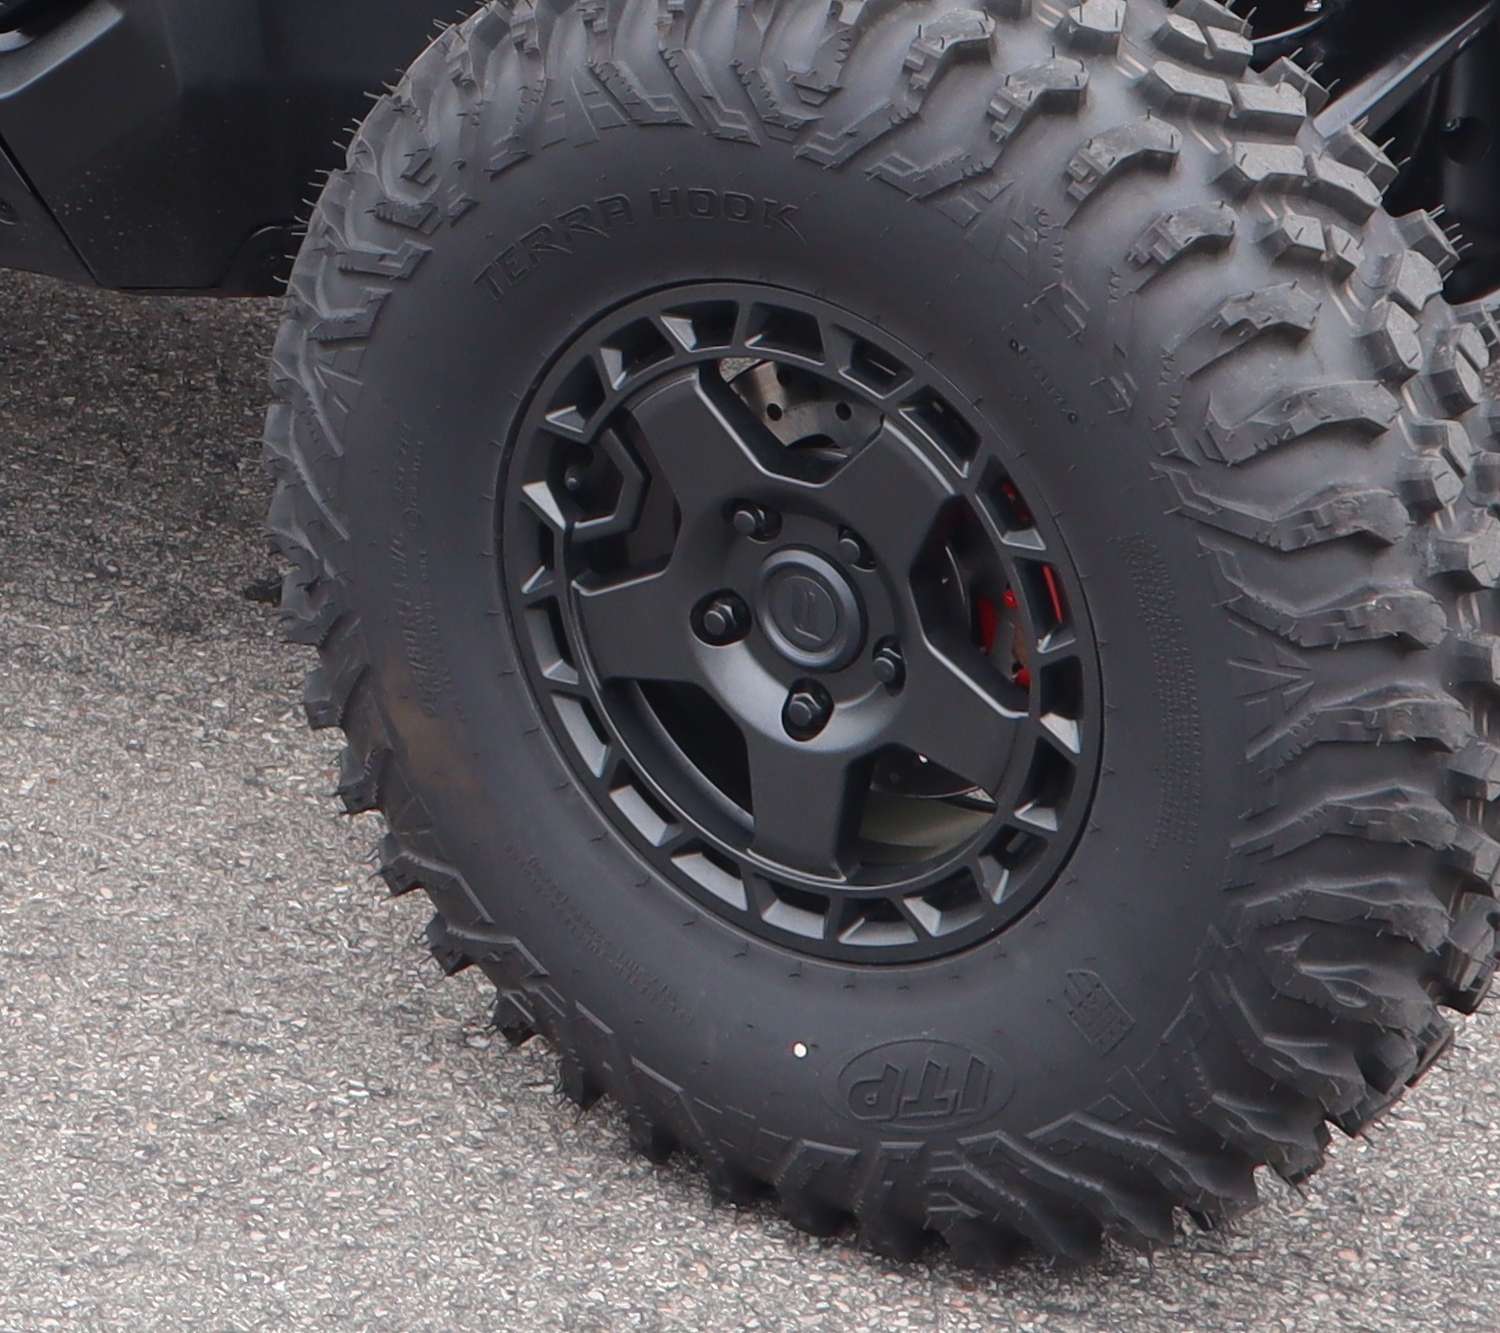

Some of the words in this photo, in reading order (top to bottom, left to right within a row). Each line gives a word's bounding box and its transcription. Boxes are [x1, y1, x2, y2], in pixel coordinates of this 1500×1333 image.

[472, 193, 635, 302] TERRA
[650, 186, 807, 245] HOOK
[848, 1055, 994, 1122] ITP
